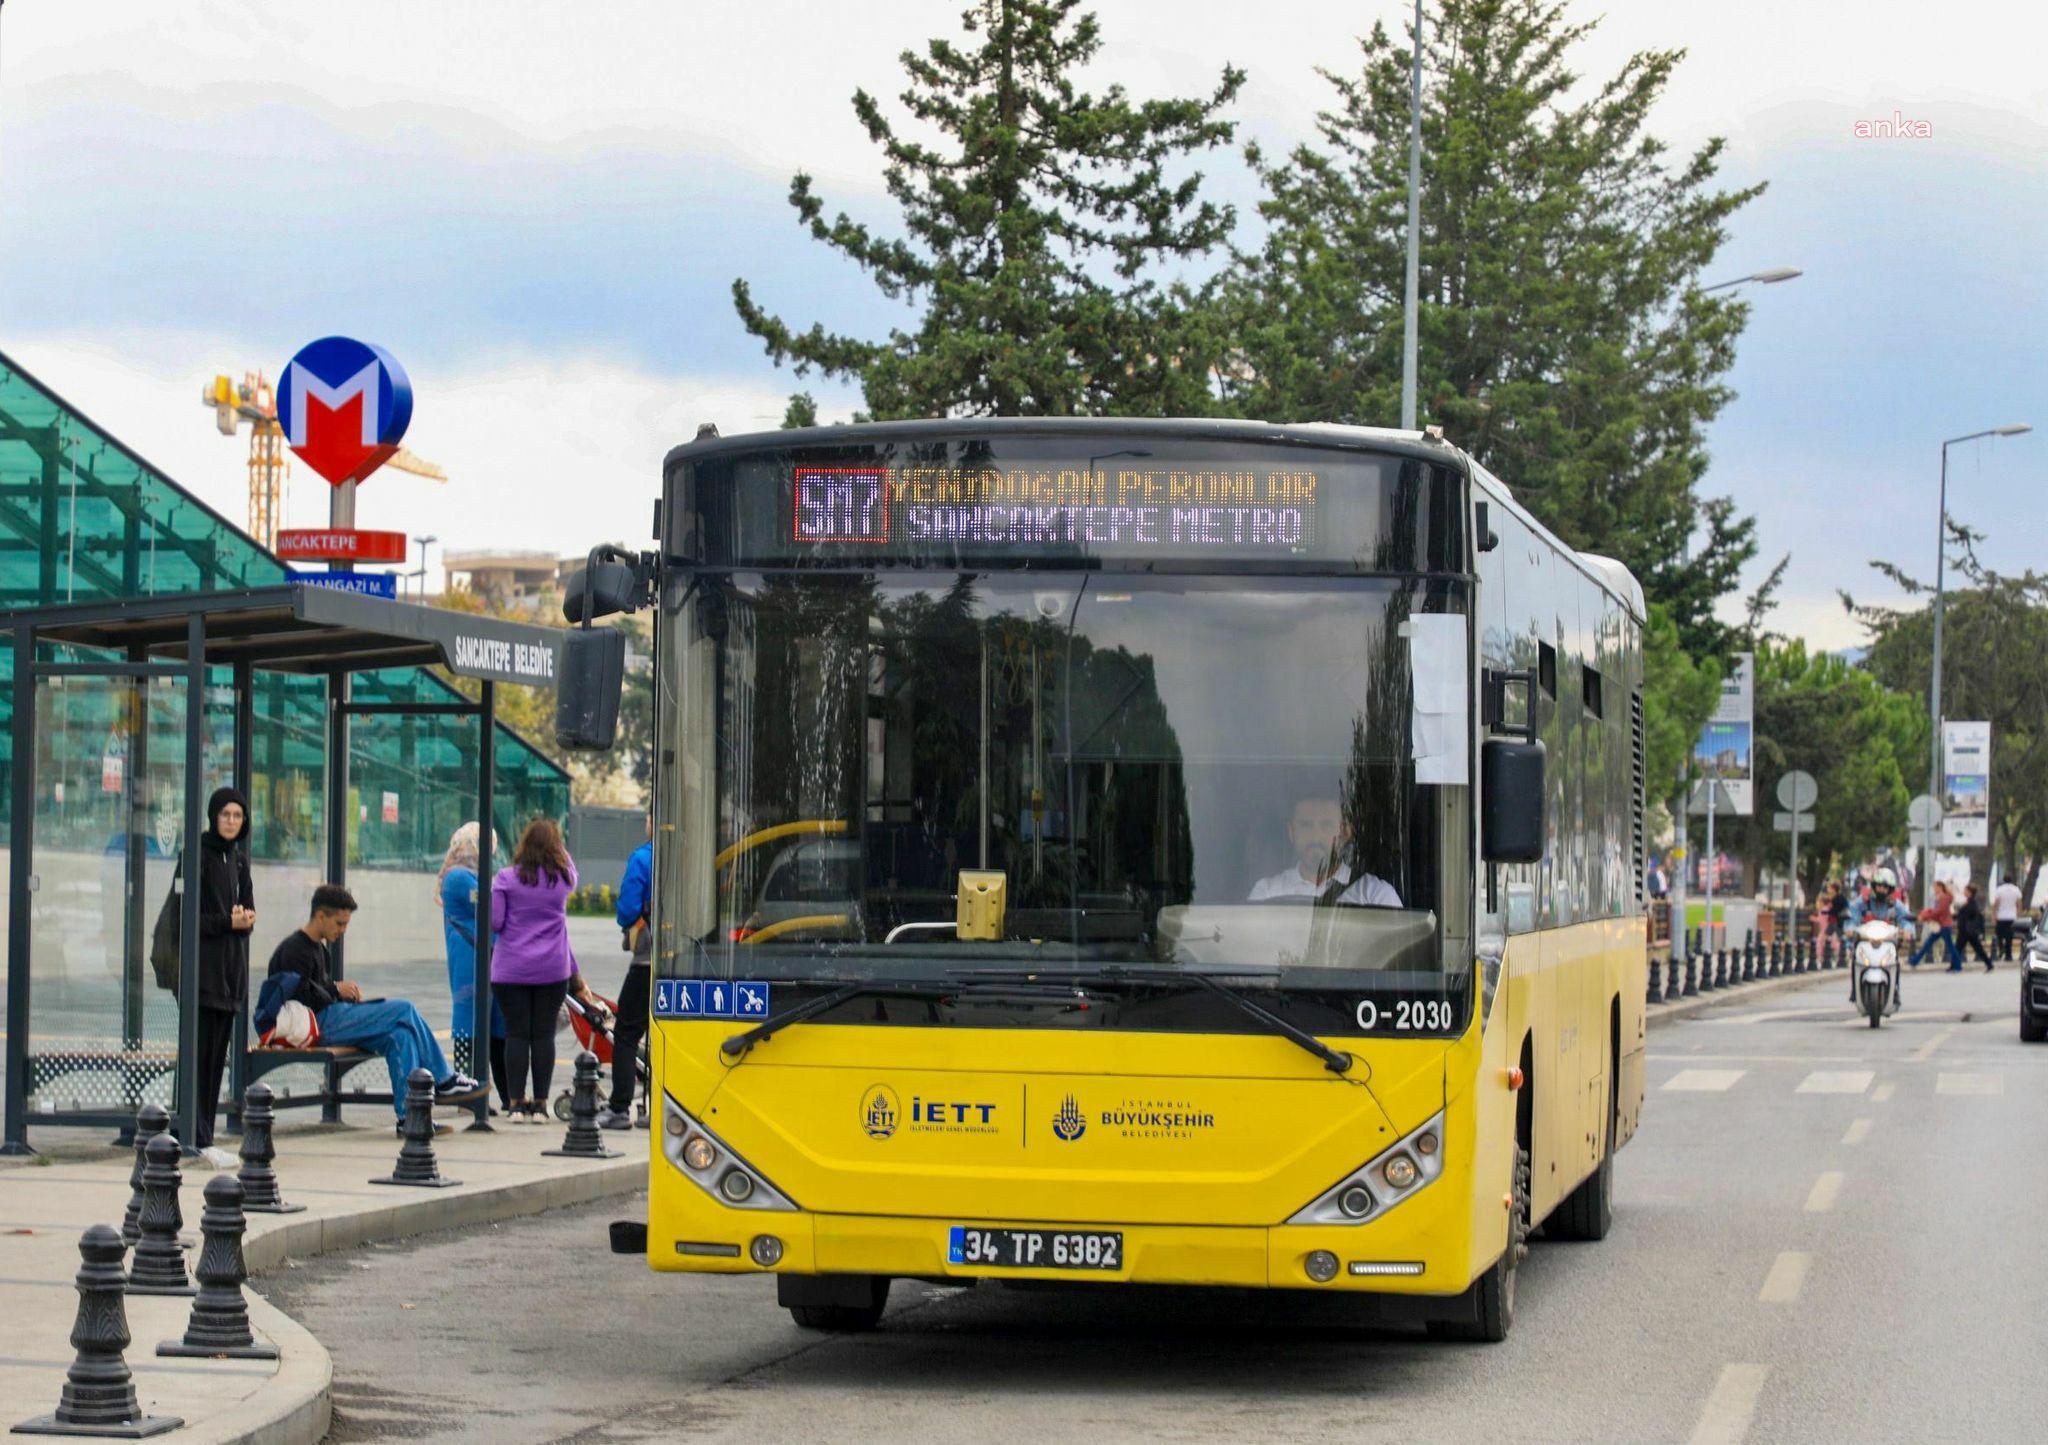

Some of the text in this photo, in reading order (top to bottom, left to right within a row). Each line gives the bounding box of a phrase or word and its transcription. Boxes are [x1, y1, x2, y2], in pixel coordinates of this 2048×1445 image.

[802, 475, 878, 534] SM7
[1118, 471, 1317, 505] PERONLAR
[909, 506, 1301, 543] SANCAKTEPE METRO
[279, 535, 358, 551] ANCAKTEPE
[456, 635, 510, 673] SANCAKTEPE
[1356, 1000, 1452, 1030] O-2030
[912, 1096, 996, 1124] İETT
[1101, 1108, 1215, 1129] BÜYÜKŞEHİR
[966, 1231, 998, 1262] 34
[1011, 1233, 1044, 1264] TP
[1053, 1234, 1118, 1266] 6382
